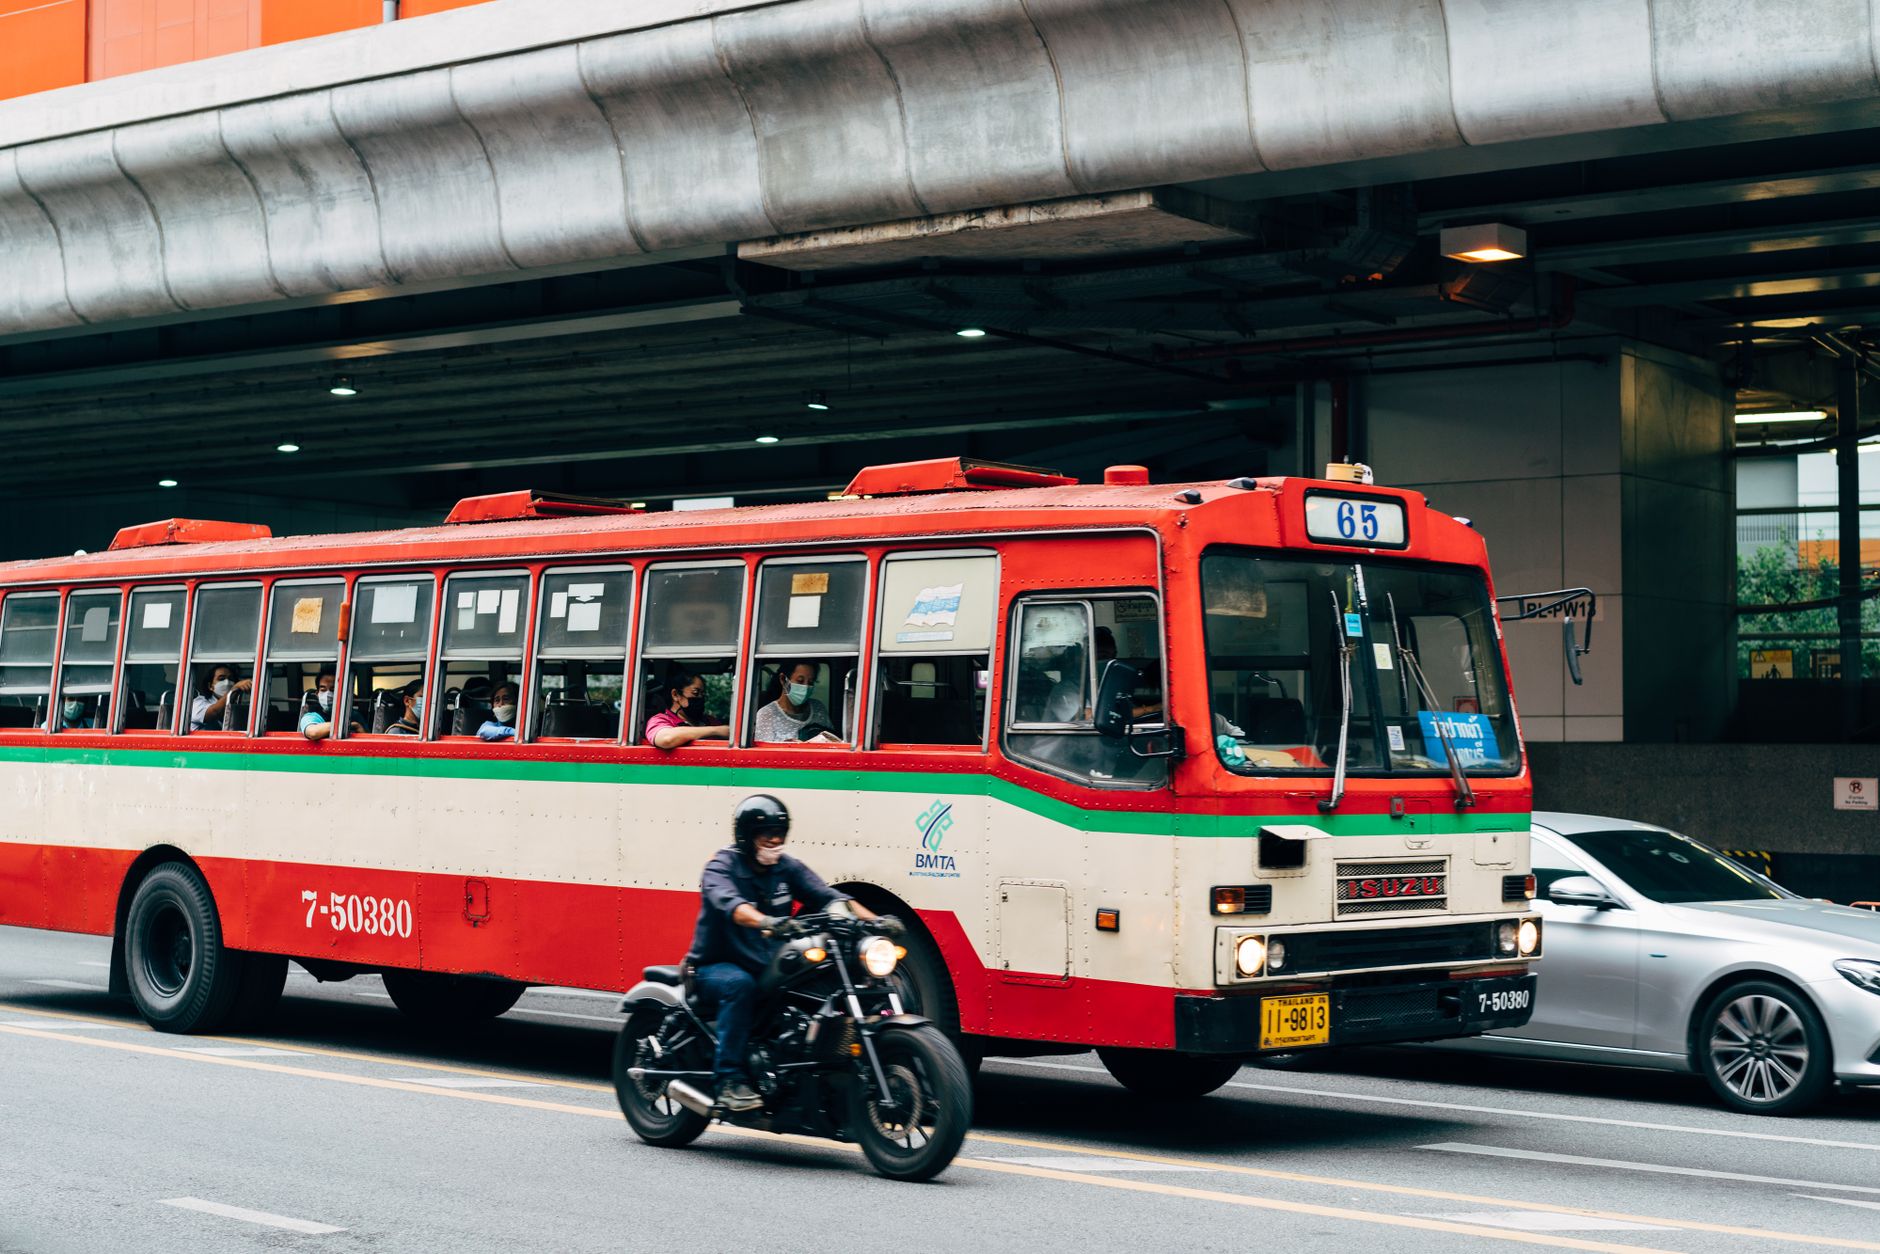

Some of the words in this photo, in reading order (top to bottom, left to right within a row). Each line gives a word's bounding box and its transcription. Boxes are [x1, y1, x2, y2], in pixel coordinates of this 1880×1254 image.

[1337, 501, 1378, 540] 65
[1526, 601, 1593, 618] BL-PW1
[915, 853, 956, 871] BMTA
[1347, 877, 1439, 898] ISUZU
[301, 889, 412, 938] 7-50380
[1478, 990, 1529, 1013] 7-50380
[1267, 1005, 1325, 1034] 11-9813
